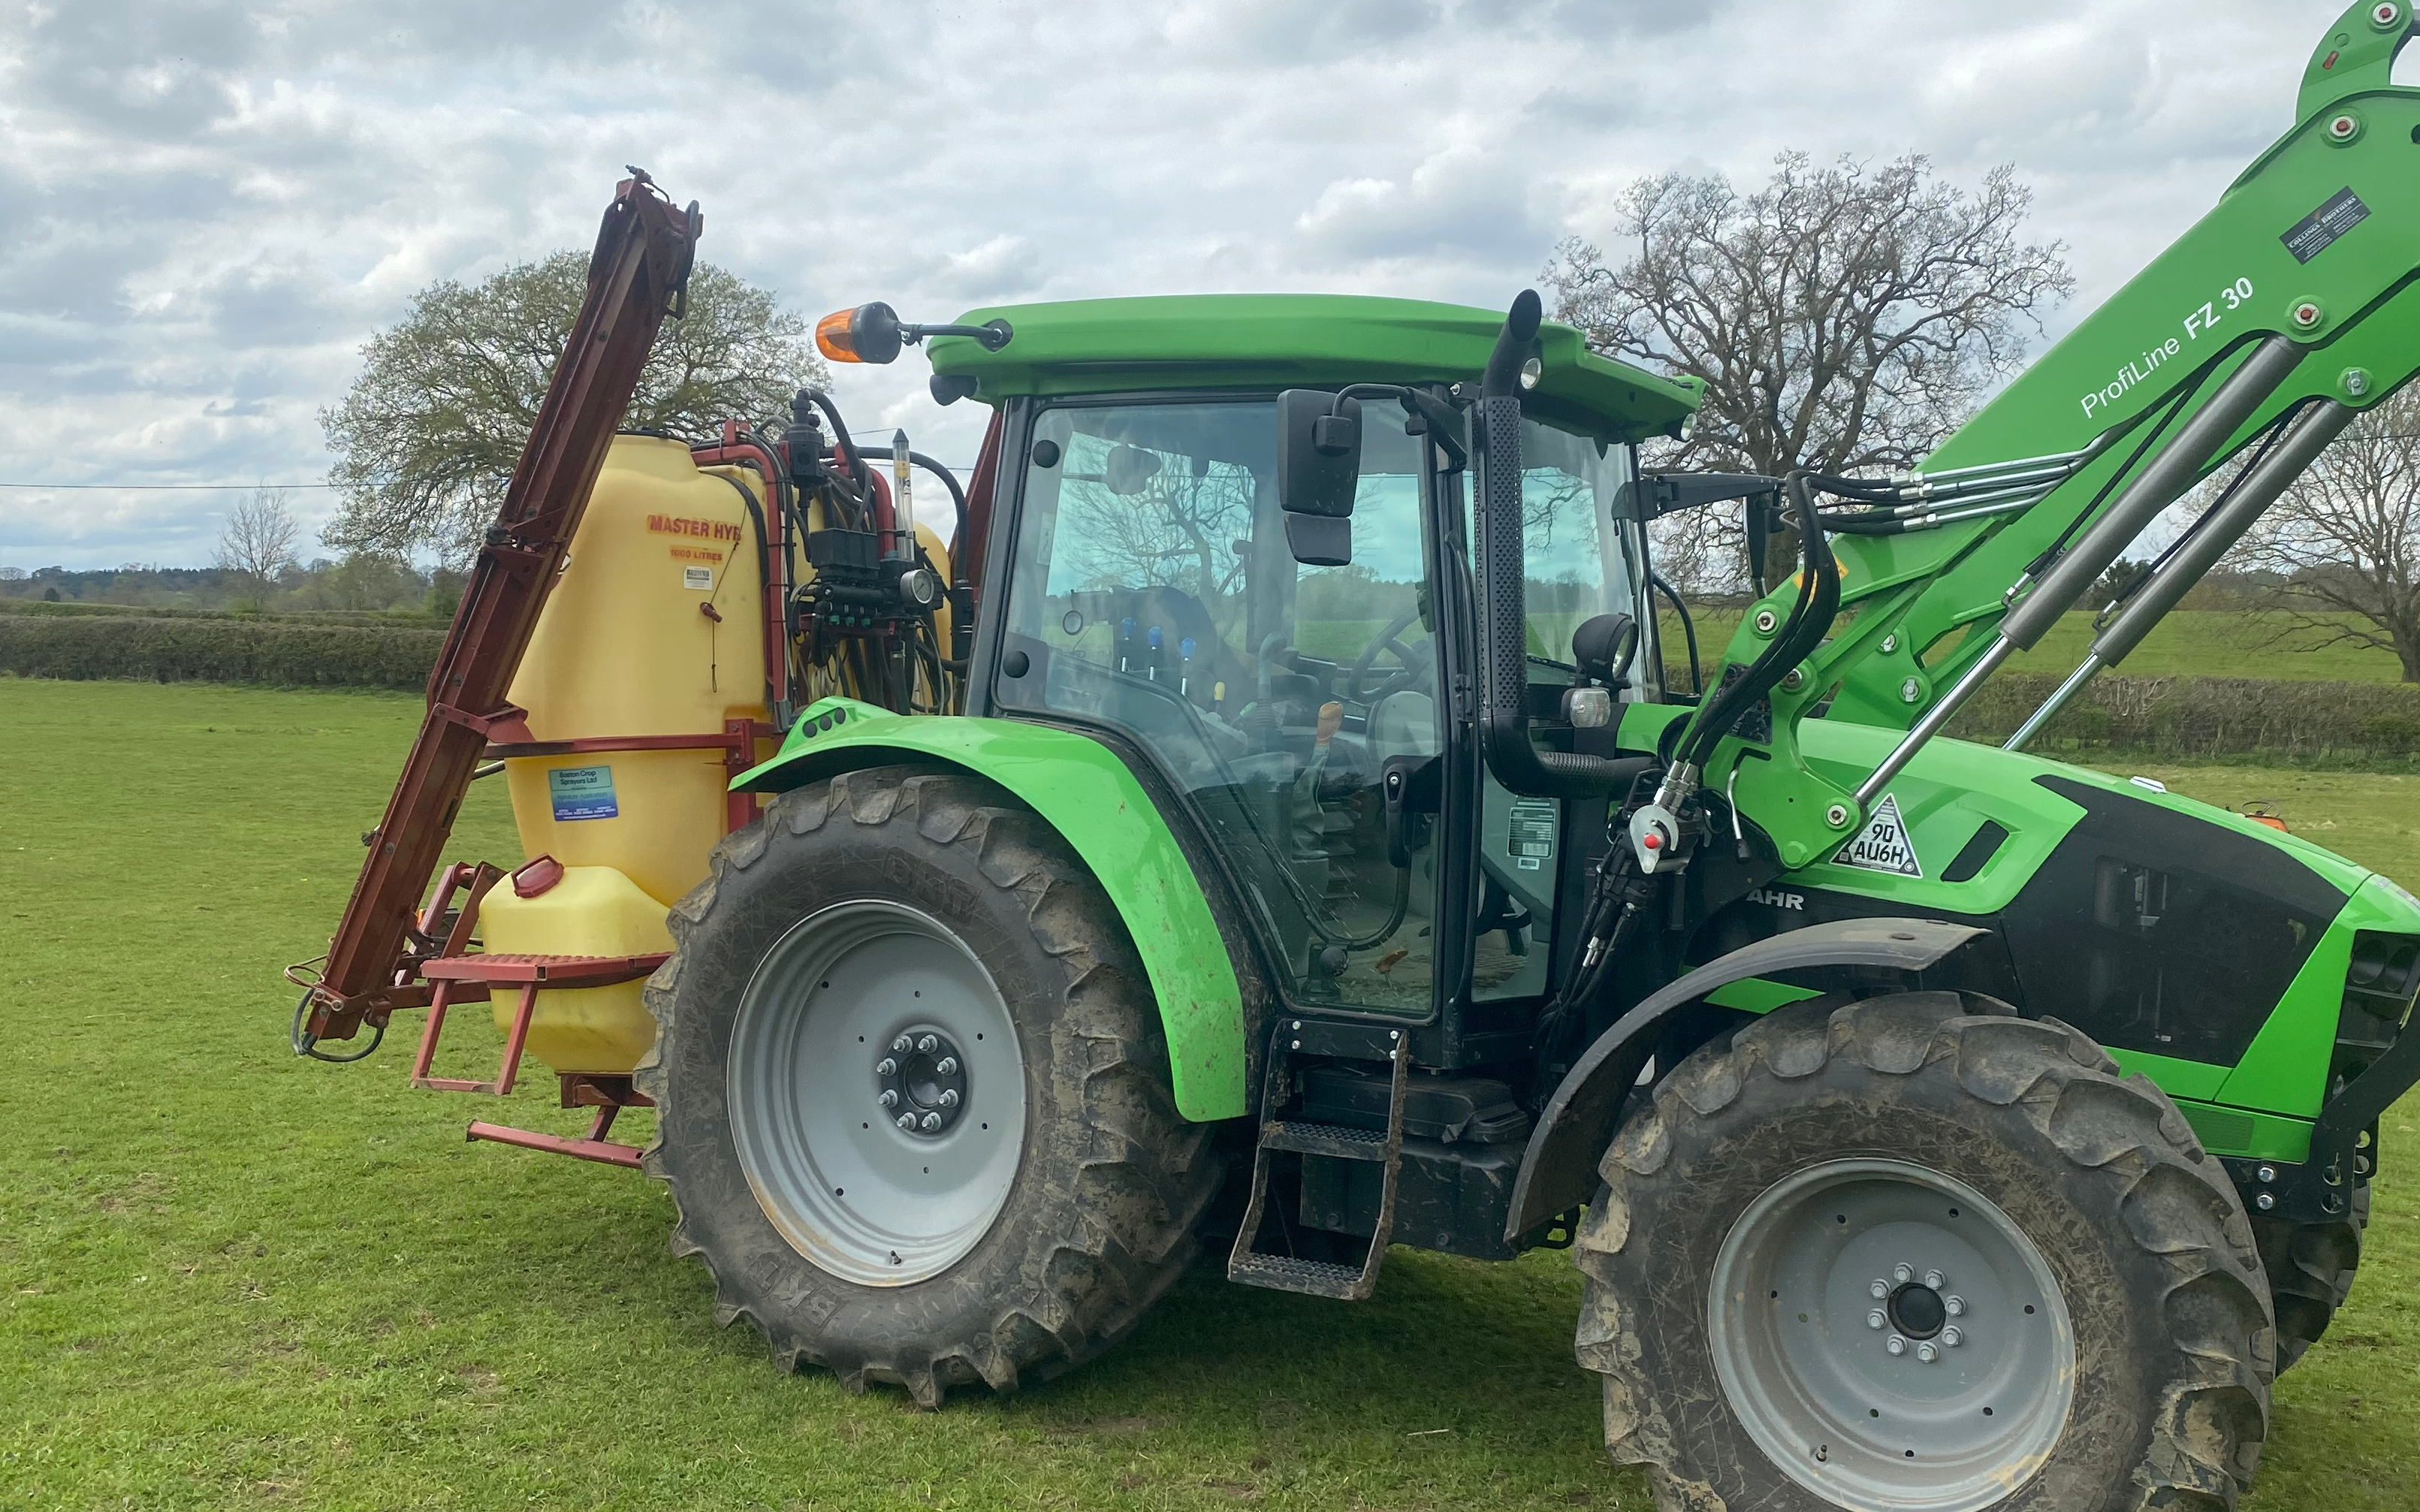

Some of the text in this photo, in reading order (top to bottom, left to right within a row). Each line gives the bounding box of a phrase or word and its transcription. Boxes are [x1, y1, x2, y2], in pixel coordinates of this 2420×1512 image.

[2081, 277, 2253, 418] ProfiLine FZ 30
[650, 515, 710, 537] MASTER
[671, 549, 722, 561] 1000 LITRES
[1854, 841, 1904, 865] AU6H
